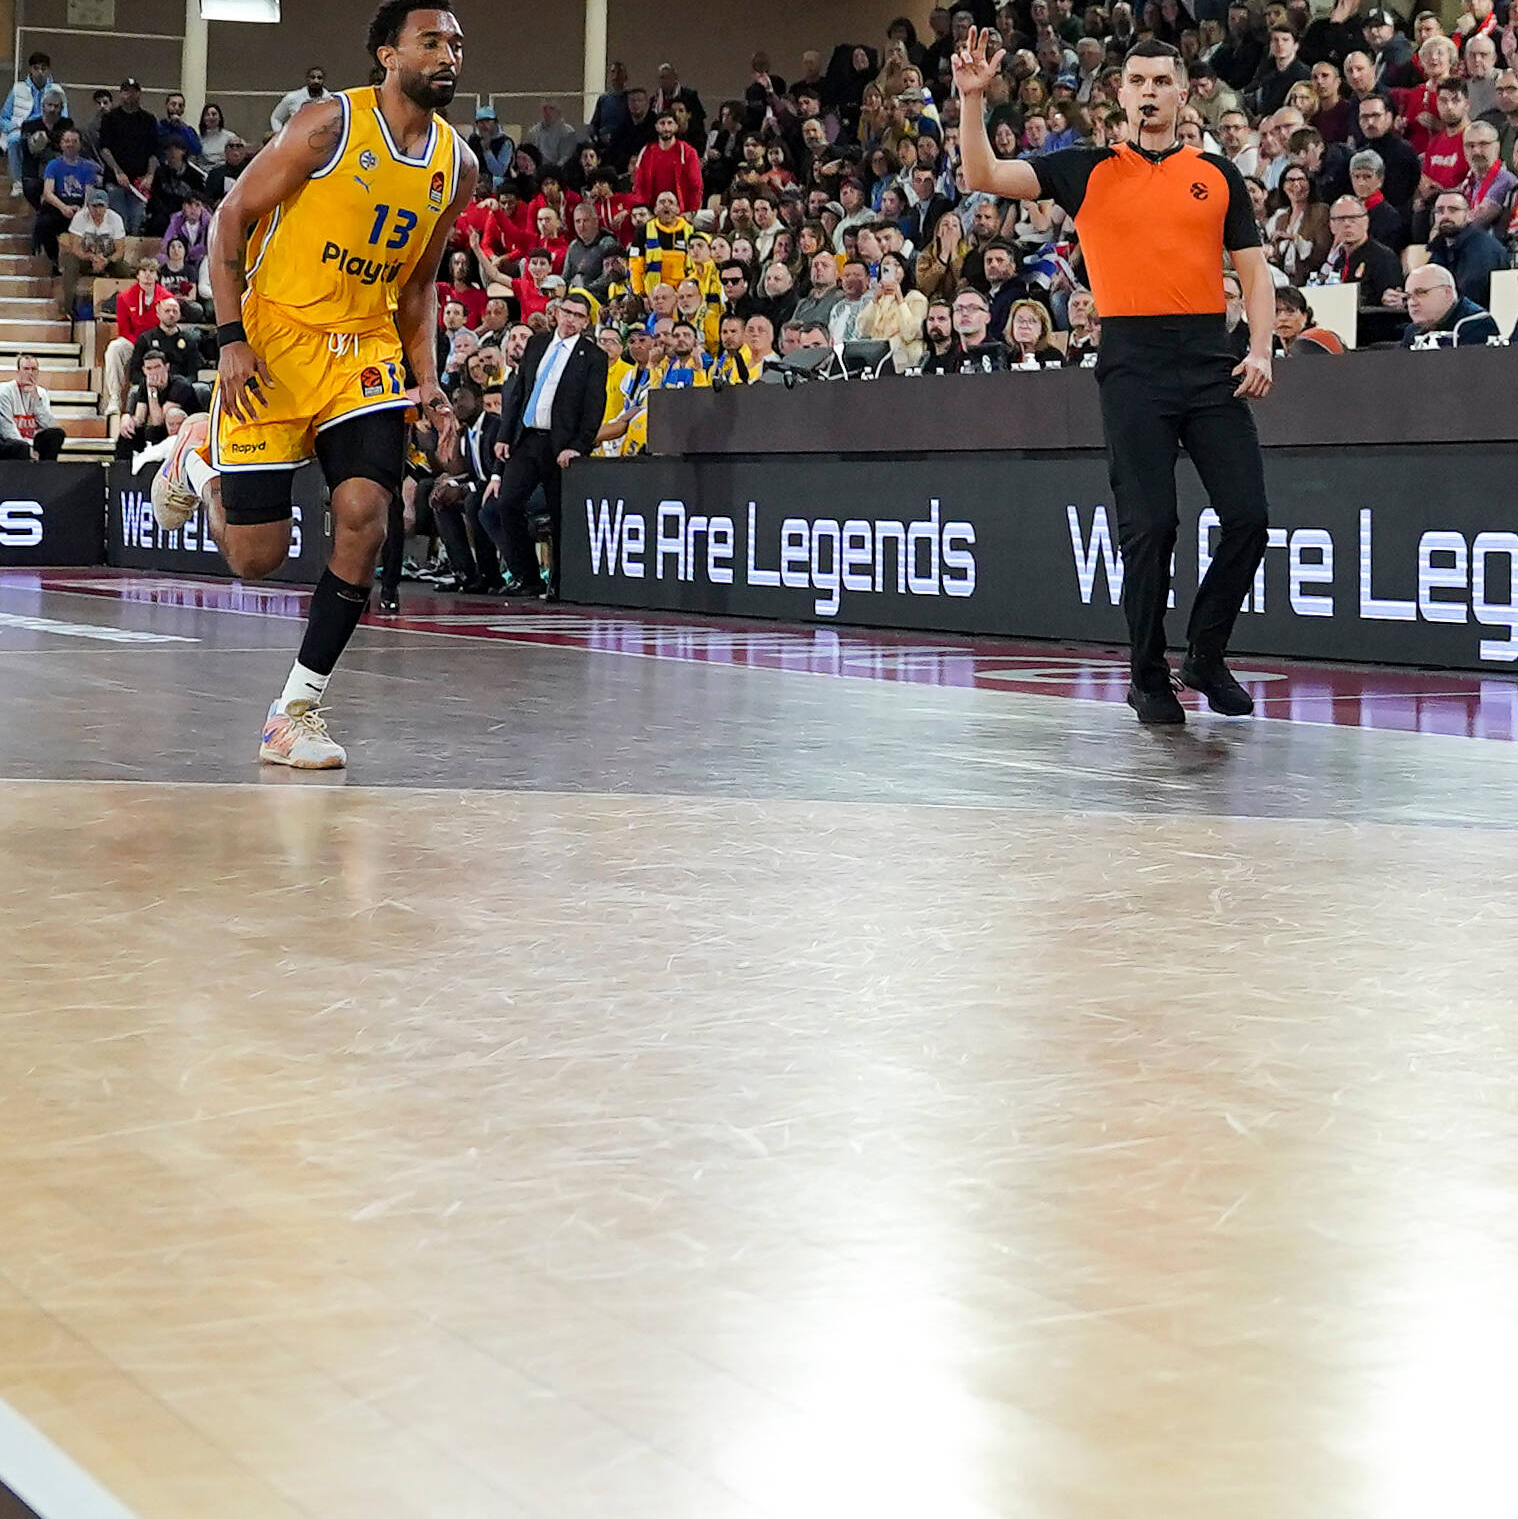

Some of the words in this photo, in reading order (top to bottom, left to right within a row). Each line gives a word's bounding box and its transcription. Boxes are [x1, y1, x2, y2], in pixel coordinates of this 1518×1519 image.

[368, 204, 418, 249] 13
[232, 441, 266, 454] Rapyd
[586, 498, 645, 578] We
[656, 500, 734, 584] Are
[747, 498, 977, 616] Legends
